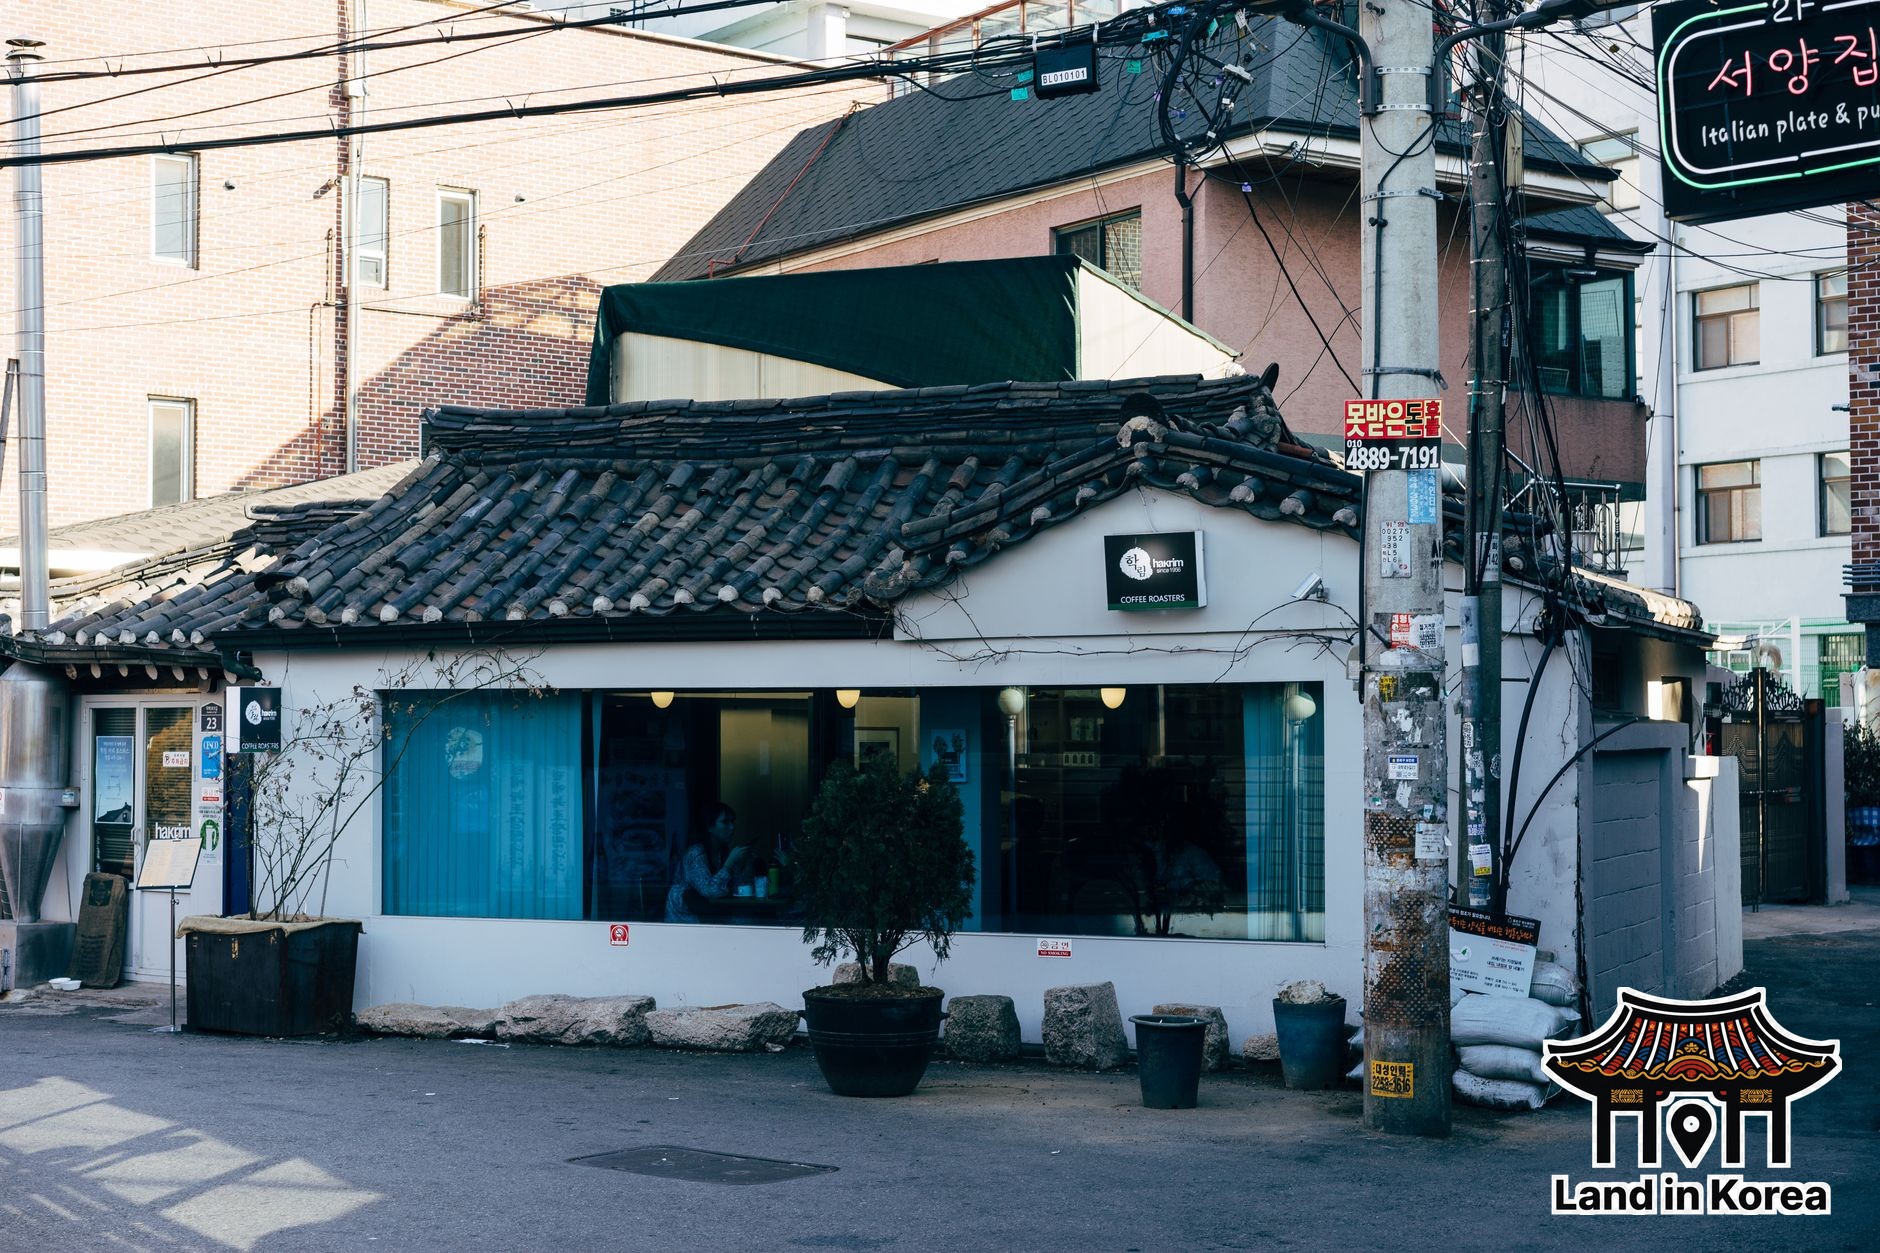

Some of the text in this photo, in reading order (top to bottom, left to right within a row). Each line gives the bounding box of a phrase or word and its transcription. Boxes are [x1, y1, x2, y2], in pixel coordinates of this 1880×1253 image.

[1707, 27, 1879, 97] 서양집
[1702, 120, 1769, 147] Italian
[1776, 110, 1828, 143] plate
[1835, 102, 1850, 124] &
[1347, 440, 1362, 448] 010
[1346, 446, 1439, 470] 4889-7191
[1152, 558, 1184, 568] hakrim
[1120, 594, 1185, 604] COFFEE ROASTERS
[206, 717, 217, 730] 23
[155, 822, 191, 839] hakrim
